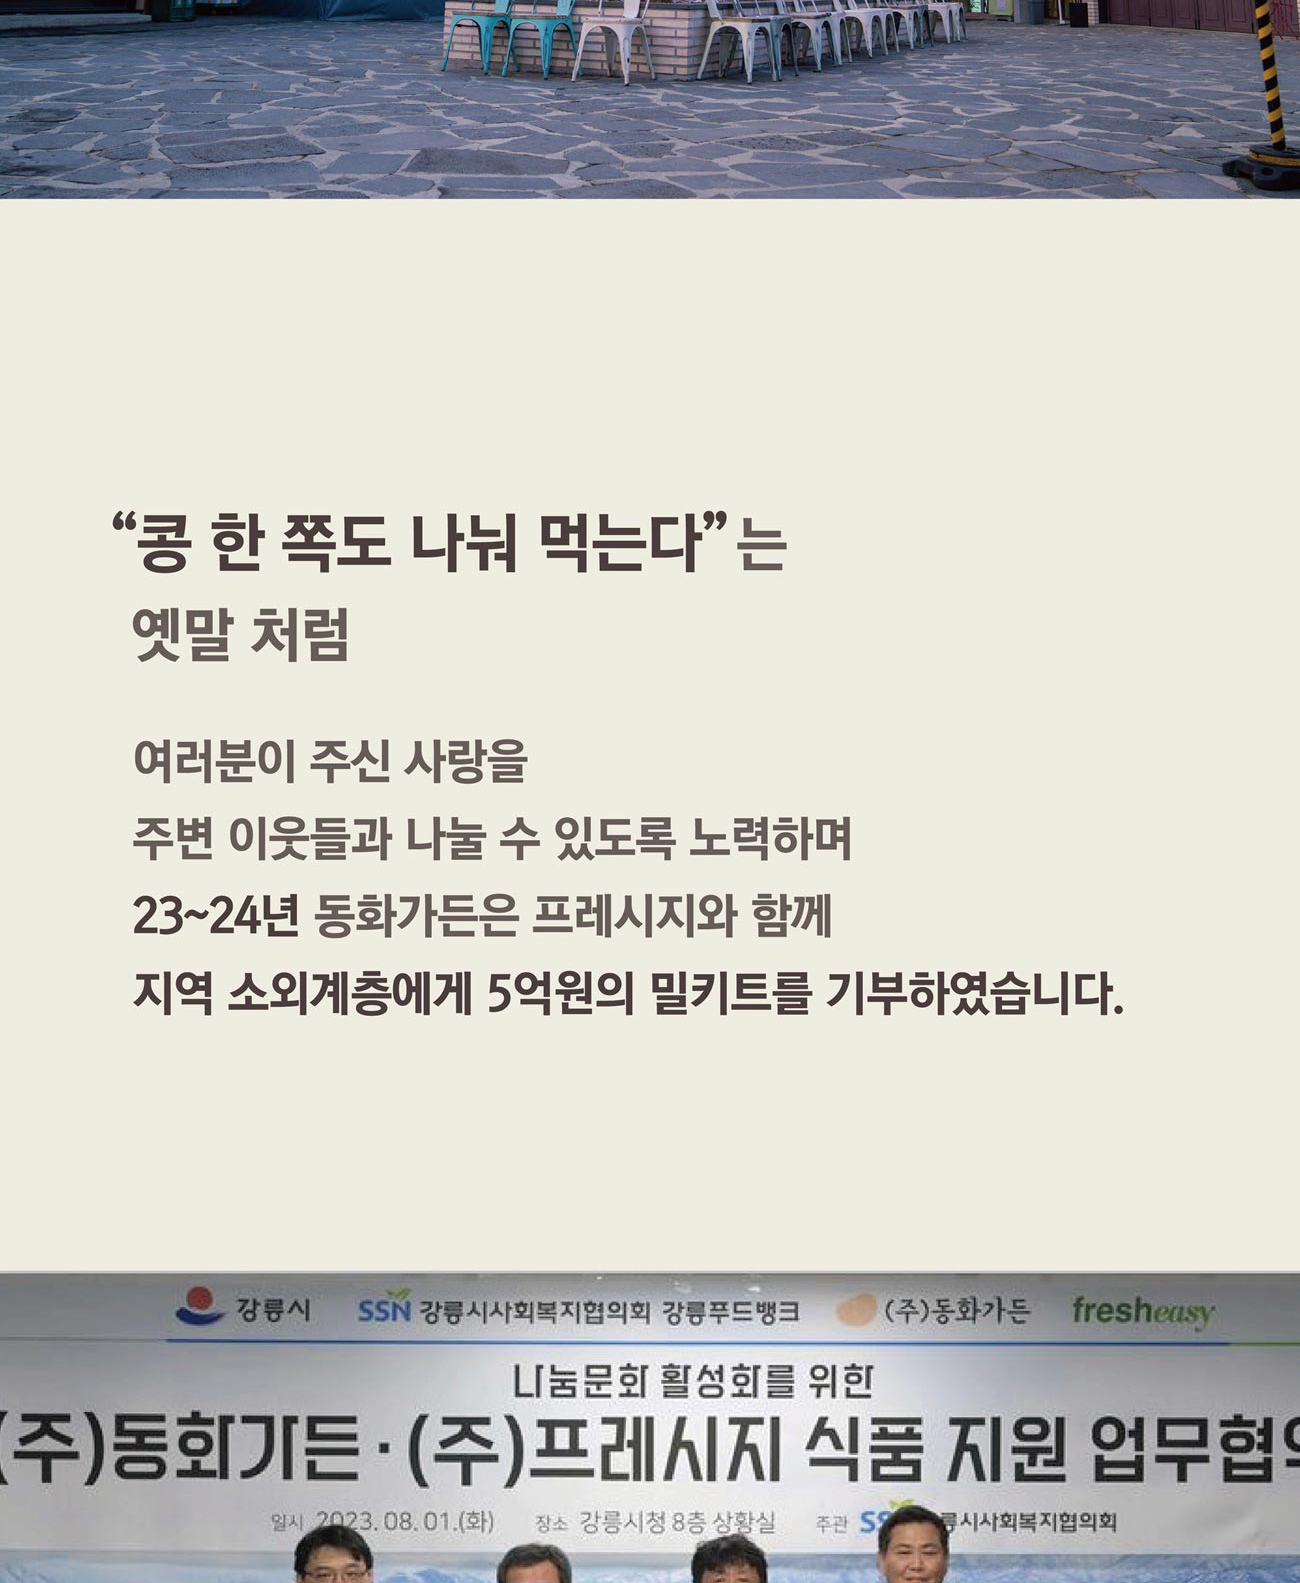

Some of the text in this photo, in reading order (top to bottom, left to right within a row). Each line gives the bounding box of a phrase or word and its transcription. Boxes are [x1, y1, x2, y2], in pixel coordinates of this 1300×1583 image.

[237, 1295, 1217, 1333] 강릉시 SSN 강릉시사회복지협의회 강릉푸드뱅크 (주)동화가든 fresheasy
[513, 1362, 875, 1400] 나눔문화 활성화를 위한
[0, 1409, 361, 1487] (주)동화가든
[408, 1413, 781, 1489] (주)프레시지
[805, 1416, 924, 1483] 식품
[947, 1416, 1067, 1484] 지원
[271, 1511, 848, 1535] 일시 장소 강릉시청 8층 상황실 주관
